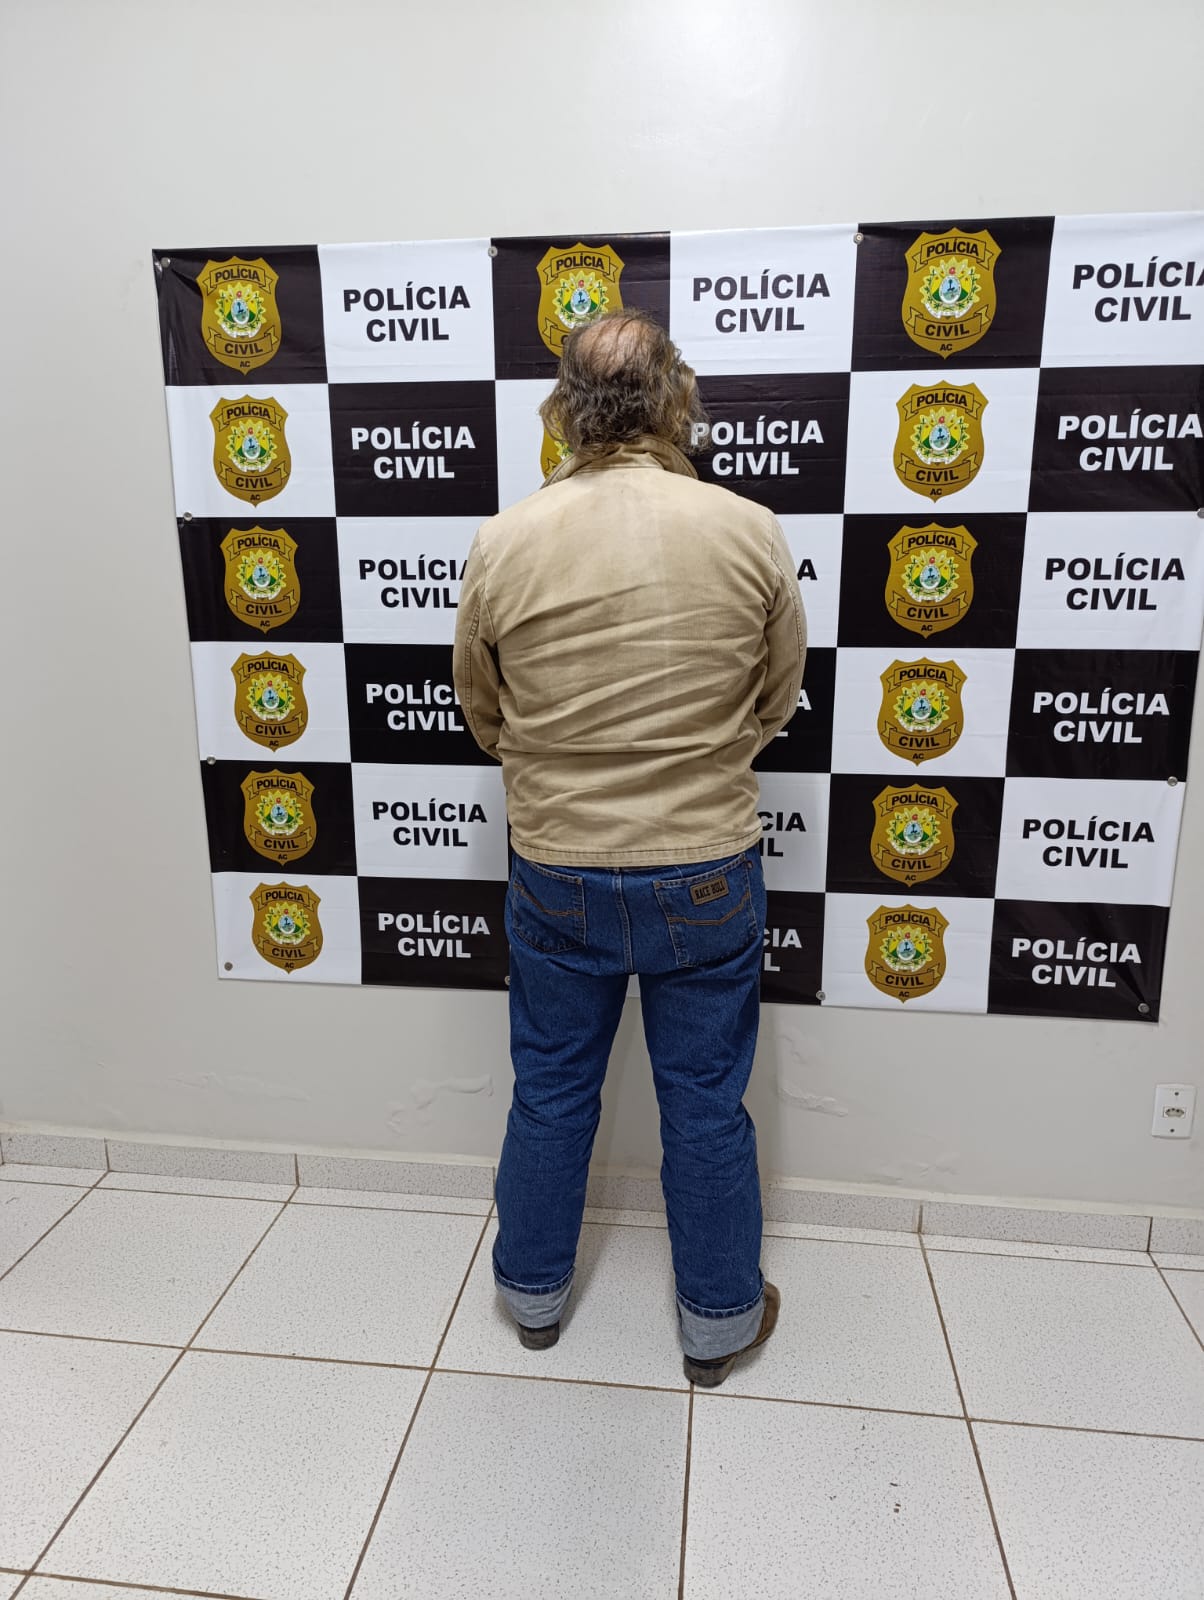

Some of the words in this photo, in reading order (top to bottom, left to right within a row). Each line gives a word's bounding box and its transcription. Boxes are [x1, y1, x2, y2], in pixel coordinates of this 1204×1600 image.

[926, 238, 979, 258] POLÍCIA
[556, 252, 605, 271] POLÍCIA
[214, 266, 261, 283] POLÍCIA
[1072, 256, 1204, 289] POLÍCI
[694, 269, 830, 301] POLÍCIA
[344, 282, 470, 312] POLÍCIA
[1095, 296, 1191, 322] CIVIL
[716, 307, 804, 332] CIVIL
[925, 323, 969, 336] CIVIL
[367, 318, 449, 342] CIVIL
[224, 343, 264, 354] CIVIL
[916, 390, 968, 407] POLÍCIA
[226, 405, 271, 420] POLÍCIA
[690, 415, 824, 446] POLÍCIA
[1058, 409, 1203, 439] POLÍCIA
[352, 422, 475, 450] POLÍCIA
[374, 456, 454, 478] CIVIL
[712, 452, 799, 475] CIVIL
[1080, 446, 1173, 471] CIVIL
[235, 476, 272, 488] CIVIL
[915, 469, 959, 481] CIVIL
[237, 534, 280, 549] POLÍCIA
[907, 531, 957, 548] POLÍCIA
[359, 554, 468, 580] POLÍCI
[1046, 553, 1184, 580] POLÍCIA
[381, 587, 459, 608] CIVIL
[1067, 588, 1156, 610] CIVIL
[245, 603, 282, 615] CIVIL
[906, 607, 949, 618] CIVIL
[247, 659, 290, 673] POLÍCIA
[899, 666, 948, 681] POLÍCIA
[366, 680, 461, 705] POLÍC
[1033, 688, 1169, 715] POLÍCIA
[255, 723, 291, 735] CIVIL
[388, 710, 464, 731] CIVIL
[899, 736, 940, 747] CIVIL
[1054, 721, 1142, 743] CIVIL
[256, 777, 297, 790] POLÍCIA
[891, 792, 939, 807] POLÍCIA
[373, 798, 487, 823] POLÍCIA
[394, 827, 468, 846] CIVIL
[1023, 816, 1154, 842] POLÍCIA
[263, 838, 299, 849] CIVIL
[891, 858, 932, 870] CIVIL
[1043, 846, 1128, 868] CIVIL
[265, 889, 305, 902] POLÍCIA
[378, 910, 490, 934] POLÍCIA
[885, 913, 930, 927] POLÍCIA
[272, 947, 306, 958] CIVIL
[398, 938, 471, 958] CIVIL
[1012, 937, 1141, 963] POLÍCIA
[885, 975, 924, 985] CIVIL
[1032, 965, 1116, 987] CIVIL
